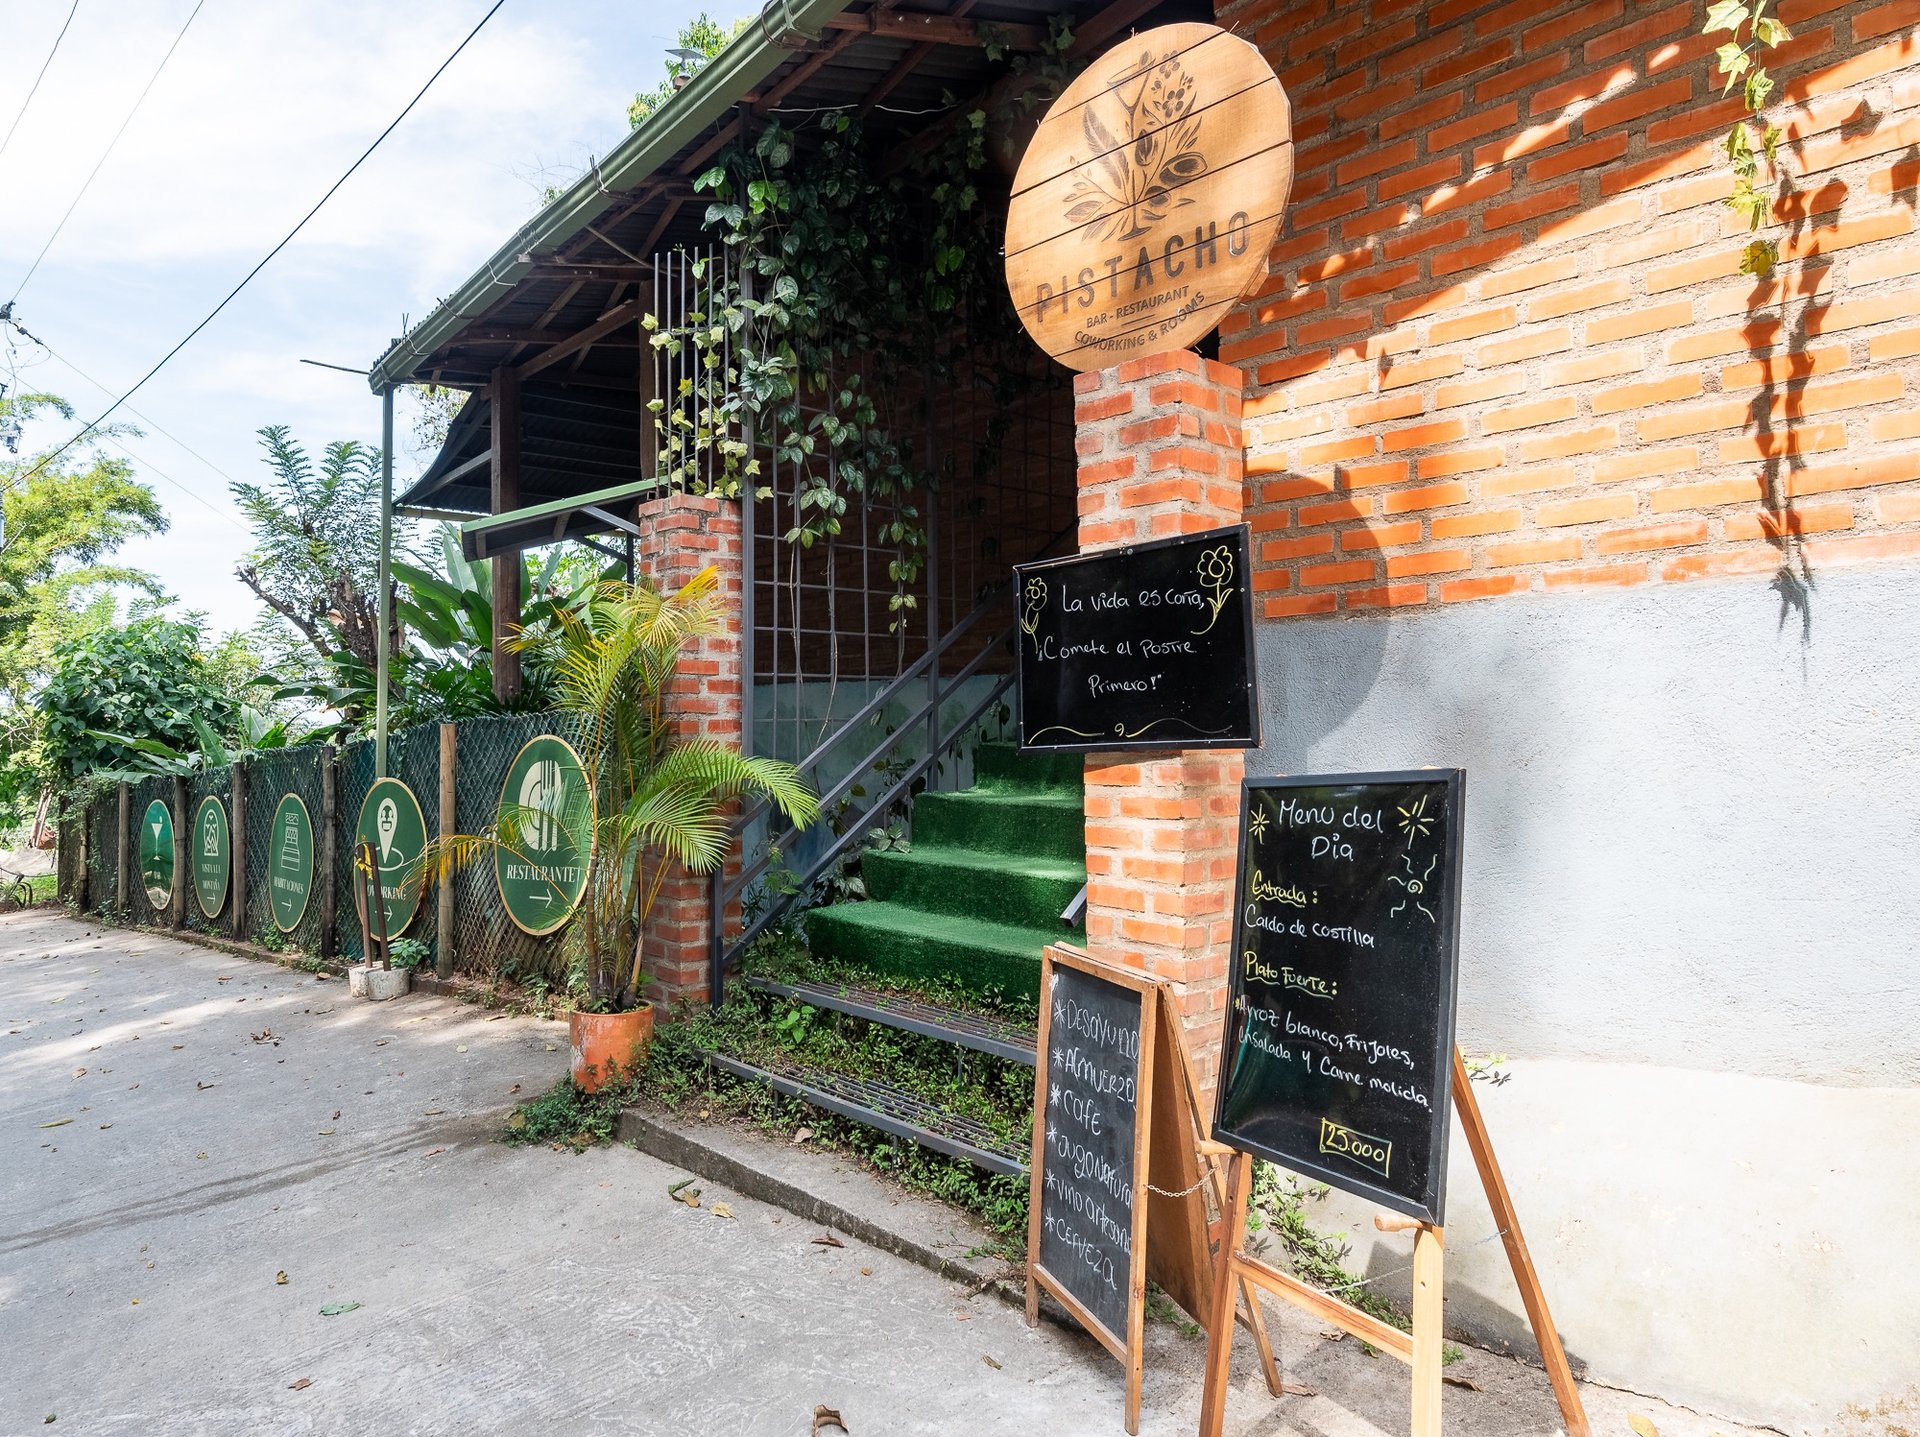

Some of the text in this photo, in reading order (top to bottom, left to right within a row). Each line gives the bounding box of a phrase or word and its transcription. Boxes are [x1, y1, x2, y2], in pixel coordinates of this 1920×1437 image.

[1036, 210, 1250, 323] PISTACHO
[1074, 330, 1146, 352] COWORKING
[1160, 290, 1206, 336] ROOMS
[1086, 312, 1108, 329] BAR
[1116, 285, 1190, 319] RESTAURANT
[1342, 805, 1384, 834] del
[506, 863, 576, 883] RESTAURANTE
[1244, 903, 1285, 934] Caldo
[1289, 918, 1308, 938] de
[1244, 950, 1278, 979] Plato
[1320, 1055, 1364, 1086] Carne
[1325, 1123, 1386, 1162] 25.000
